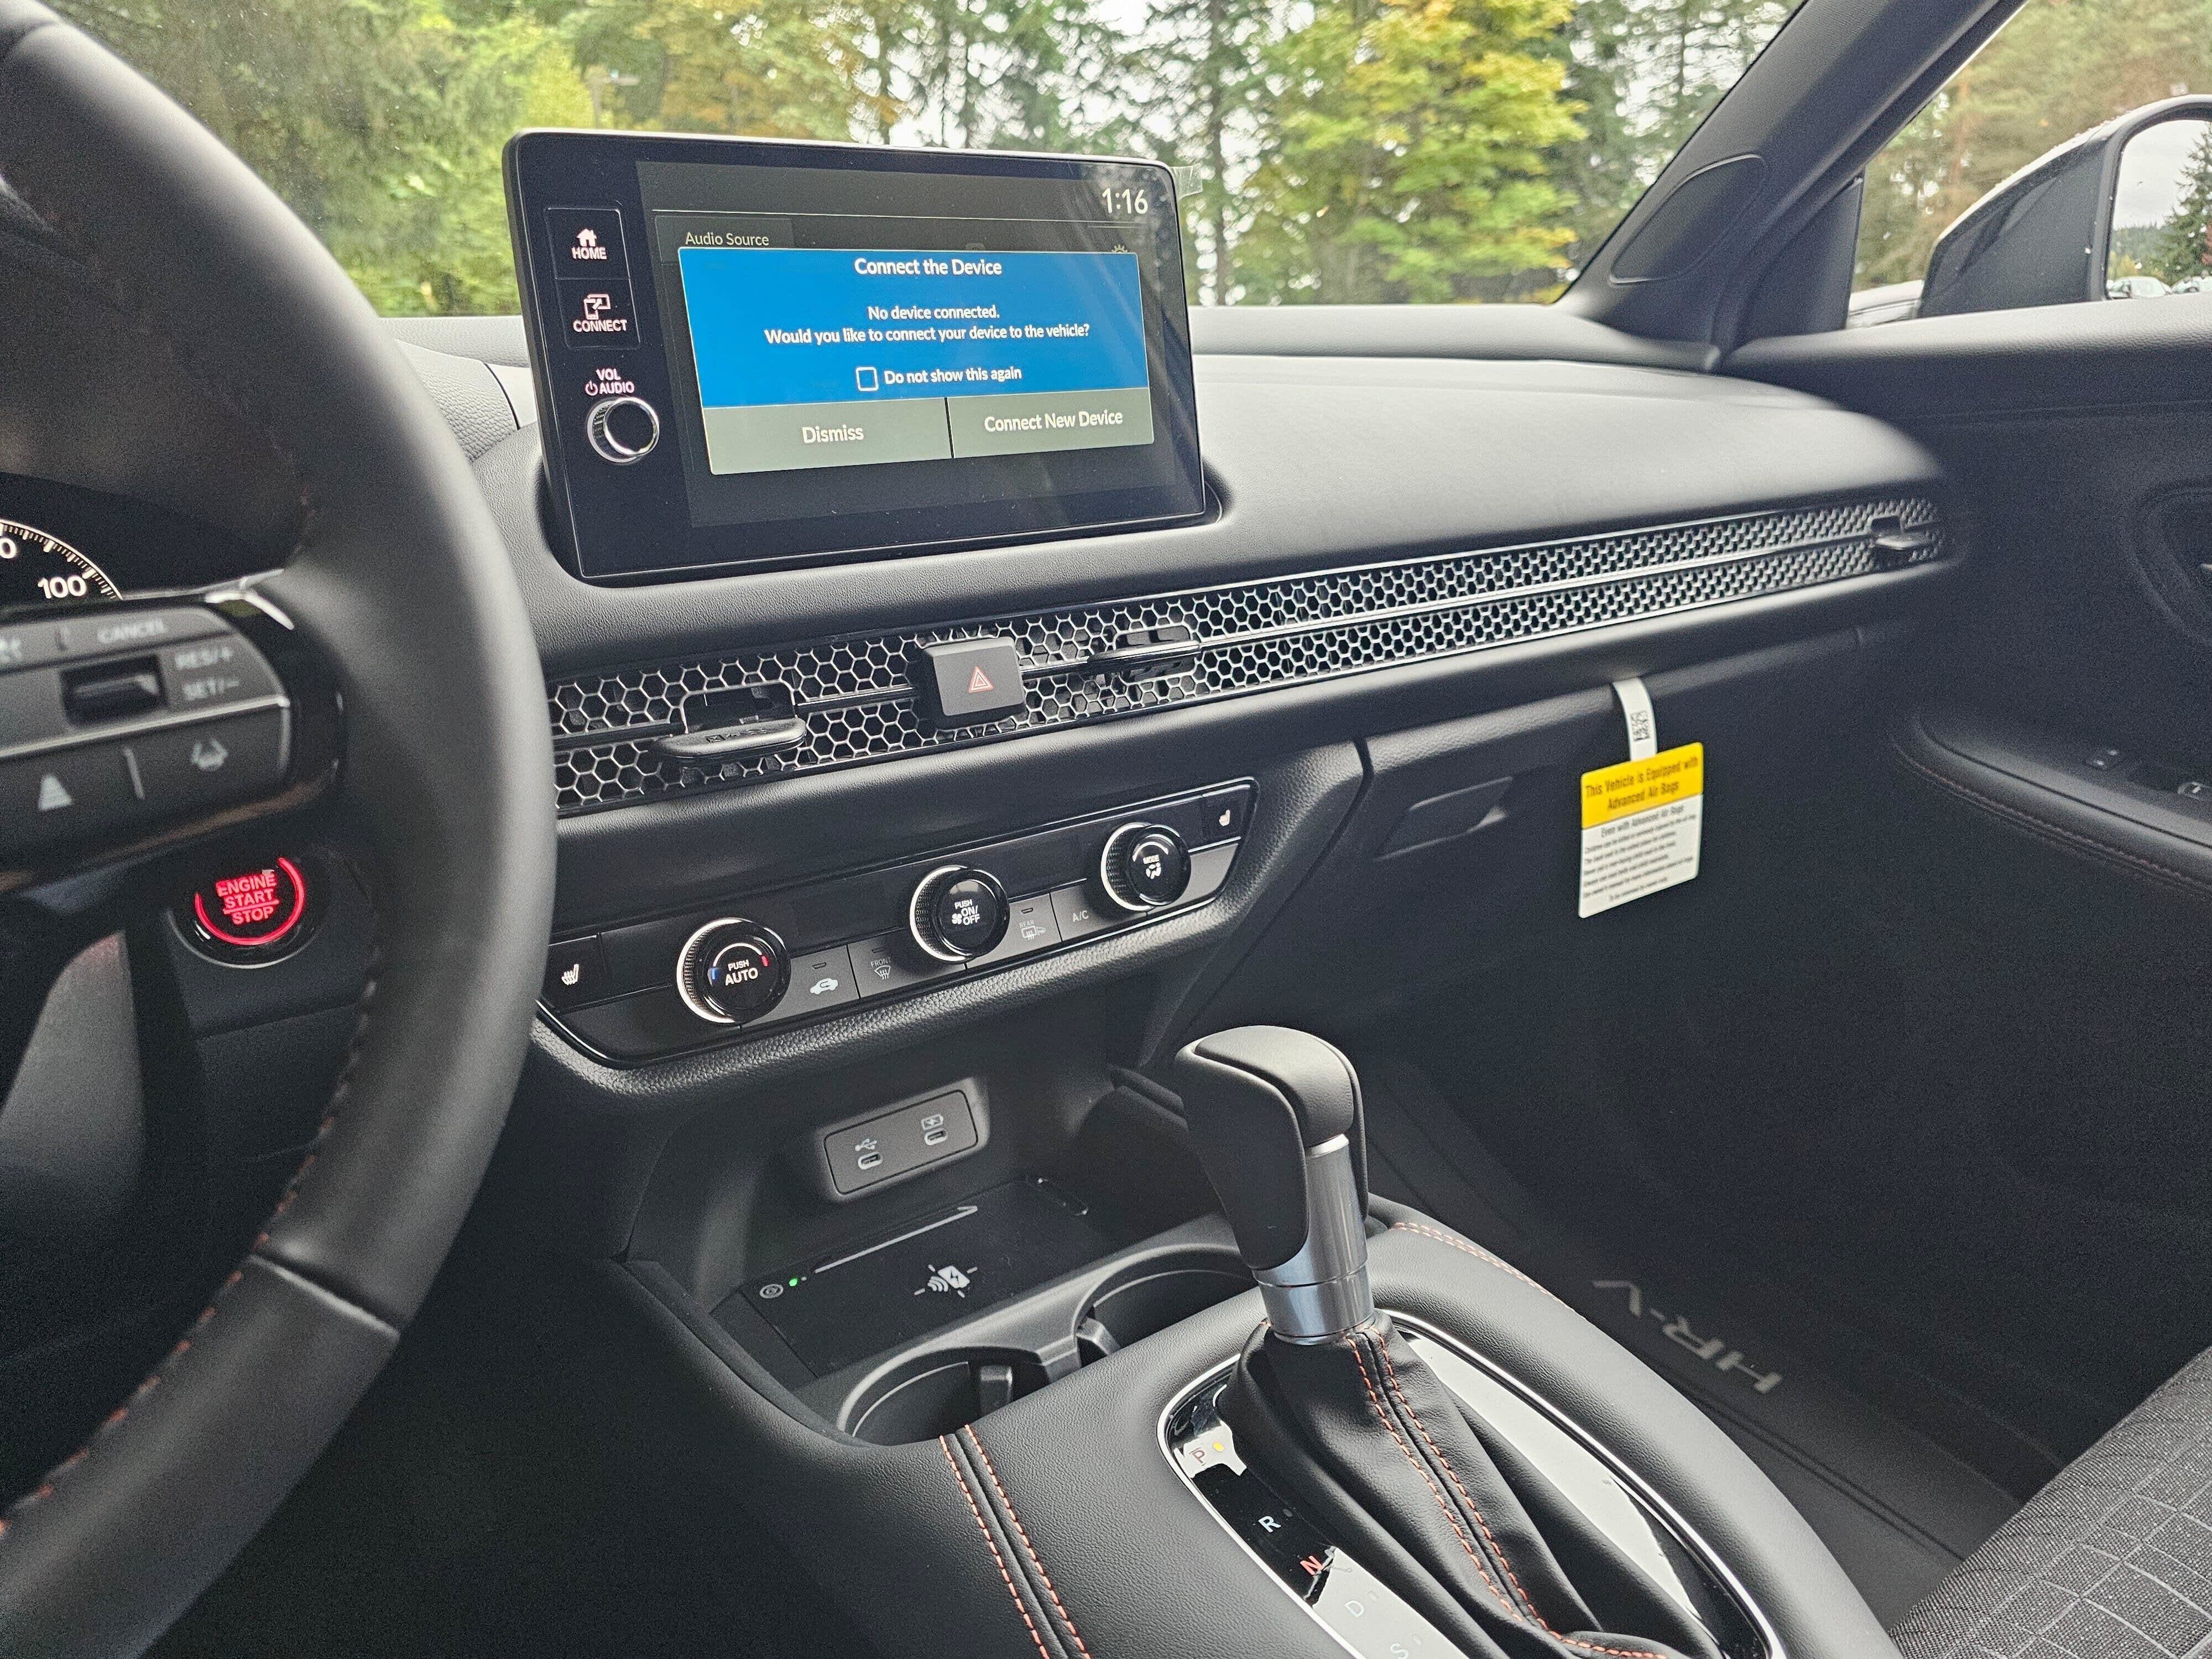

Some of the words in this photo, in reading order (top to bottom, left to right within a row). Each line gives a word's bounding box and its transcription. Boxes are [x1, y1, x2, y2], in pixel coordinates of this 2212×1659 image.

[1102, 188, 1148, 214] 1:16
[686, 232, 723, 245] Audio
[726, 233, 769, 246] Source
[571, 247, 607, 260] HOME
[854, 258, 920, 275] Connect
[923, 259, 948, 275] the
[952, 259, 1002, 275] Device
[868, 306, 888, 320] No
[891, 305, 931, 320] device
[934, 305, 1000, 319] connected.
[573, 319, 627, 332] CONNECT
[764, 328, 811, 344] Would
[813, 331, 840, 345] you
[842, 327, 866, 342] like
[868, 328, 883, 342] to
[885, 327, 936, 341] connect
[938, 328, 967, 343] your
[969, 325, 1008, 340] device
[1009, 325, 1022, 338] to
[1024, 324, 1044, 338] the
[1045, 323, 1090, 337] vehicle?
[596, 368, 621, 380] VOL
[884, 371, 904, 385] Do
[906, 370, 928, 383] not
[930, 369, 963, 383] show
[966, 367, 988, 382] this
[991, 366, 1022, 382] again
[599, 382, 635, 394] AUDIO
[984, 414, 1042, 432] Connect
[1044, 413, 1076, 429] New
[1078, 409, 1123, 427] Device
[802, 424, 864, 444] Dismiss
[38, 575, 87, 599] 100
[97, 618, 166, 644] CANCEL
[1585, 784, 1602, 798] This
[1604, 775, 1634, 792] Vehicle
[1637, 771, 1644, 783] is
[1646, 760, 1681, 781] Equipped
[1684, 756, 1698, 769] with
[1607, 790, 1645, 812] Advanced
[1648, 786, 1658, 797] Air
[1661, 781, 1679, 795] Bags
[216, 872, 277, 897] ENGINE
[224, 888, 275, 909] START
[954, 899, 973, 909] PUSH
[232, 905, 274, 925] STOP
[961, 905, 978, 917] ON/
[963, 913, 980, 926] OFF
[1073, 910, 1089, 922] A/C
[1019, 920, 1034, 928] REAR
[728, 959, 749, 972] PUSH
[870, 957, 891, 968] FRONT
[724, 968, 758, 986] AUTO
[1593, 1280, 1782, 1395] HR-V
[1190, 1447, 1206, 1466] P
[1257, 1515, 1282, 1533] R
[1299, 1555, 1324, 1575] N
[1344, 1600, 1365, 1618] D
[1390, 1642, 1409, 1659] S
